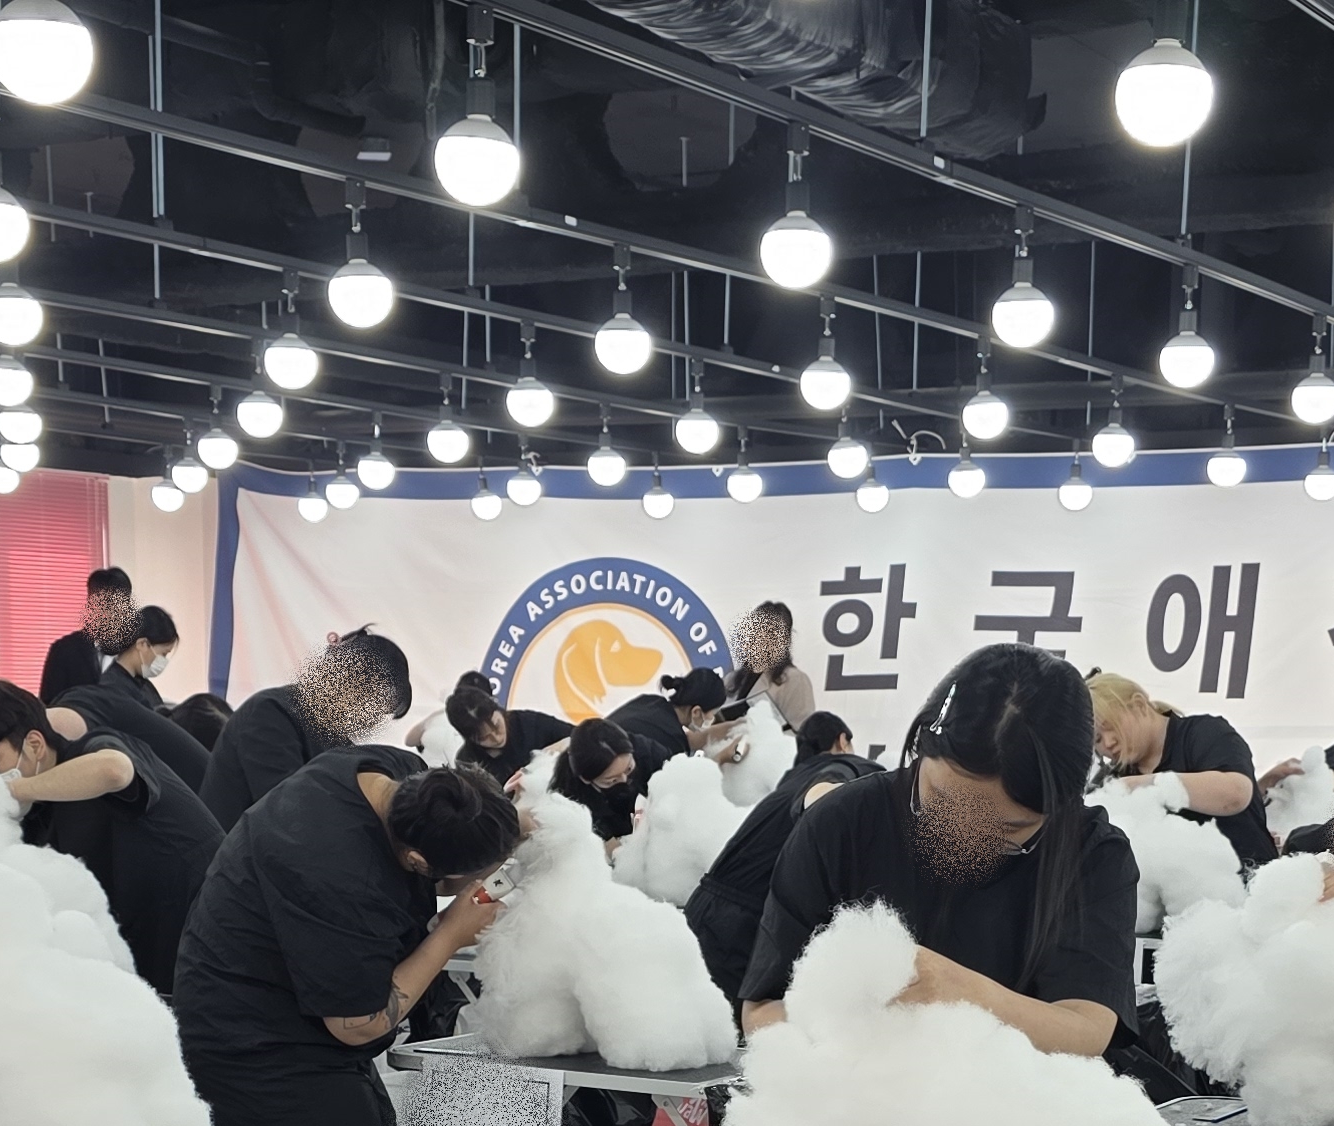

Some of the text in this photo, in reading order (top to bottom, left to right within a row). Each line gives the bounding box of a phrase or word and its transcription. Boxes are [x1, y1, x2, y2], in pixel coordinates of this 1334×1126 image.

[488, 570, 718, 696] OREA ASSOCIATION OF
